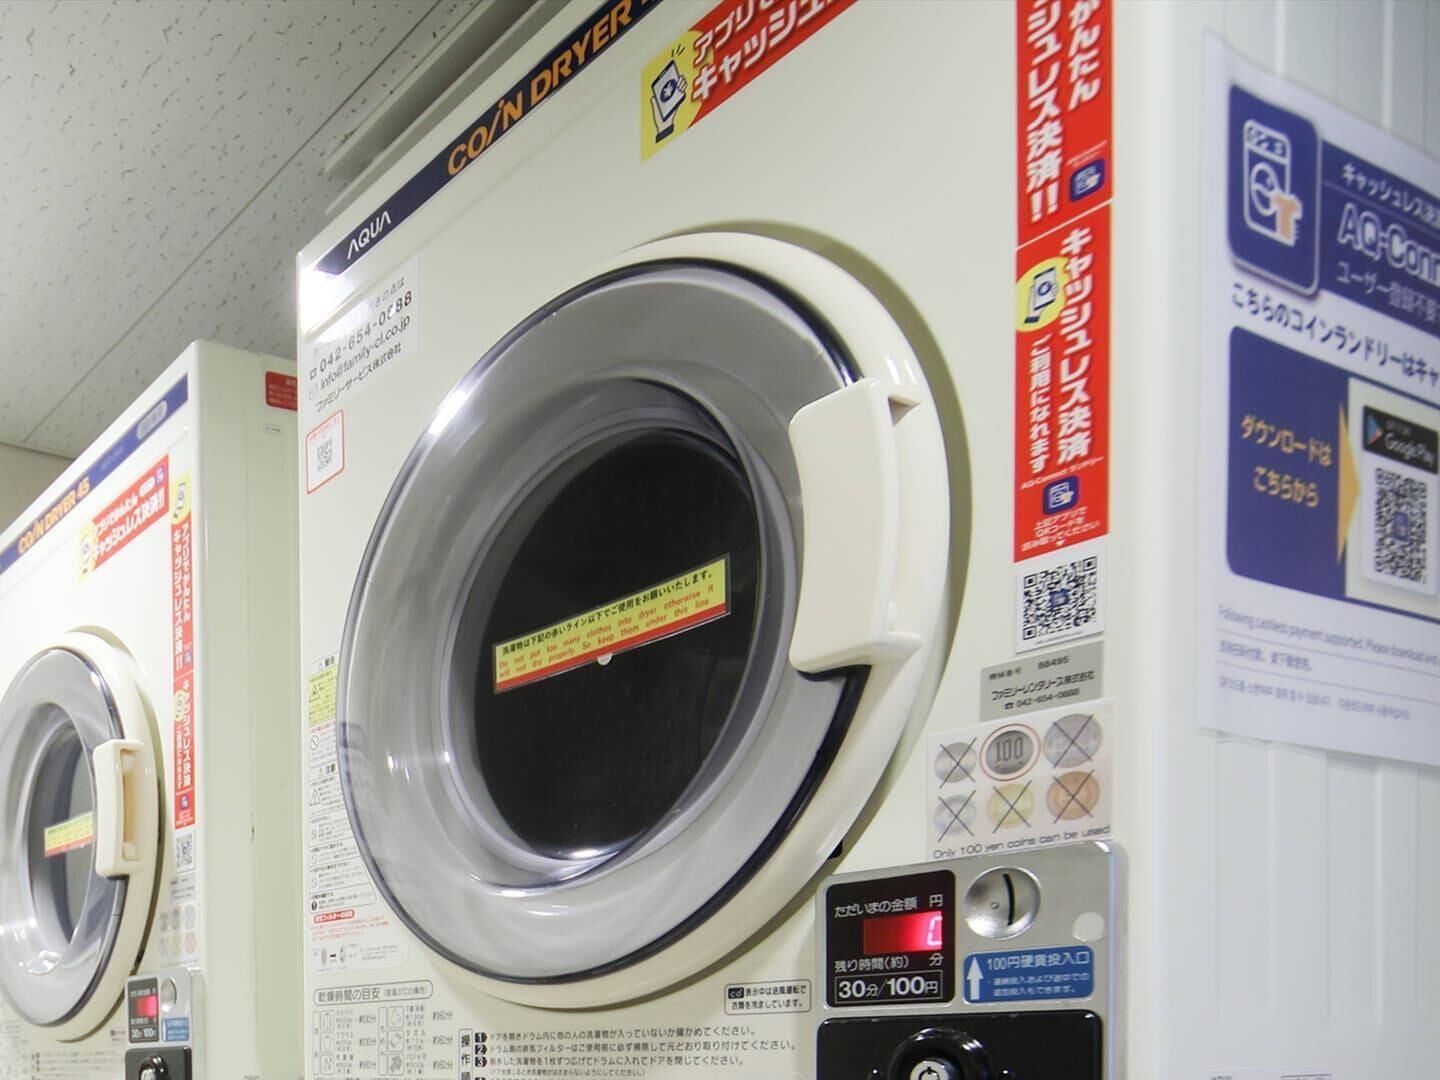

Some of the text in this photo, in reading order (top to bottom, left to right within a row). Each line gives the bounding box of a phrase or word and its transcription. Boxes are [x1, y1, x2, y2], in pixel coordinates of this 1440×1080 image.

[531, 0, 633, 106] DRYER
[1027, 0, 1063, 223] シュレス決済!!
[347, 211, 391, 259] AQUA
[1058, 227, 1093, 465] キャッシュレス決済
[1030, 333, 1052, 474] ご利用になれます
[1241, 414, 1334, 467] ダウンロードは
[1253, 466, 1320, 508] こちらから
[960, 844, 982, 855] 100
[1007, 836, 1036, 848] coins
[1040, 832, 1061, 844] can
[834, 894, 944, 919] ただいまの金額 円
[929, 953, 944, 967] 分
[987, 951, 1090, 970] 100円硬貨投入口
